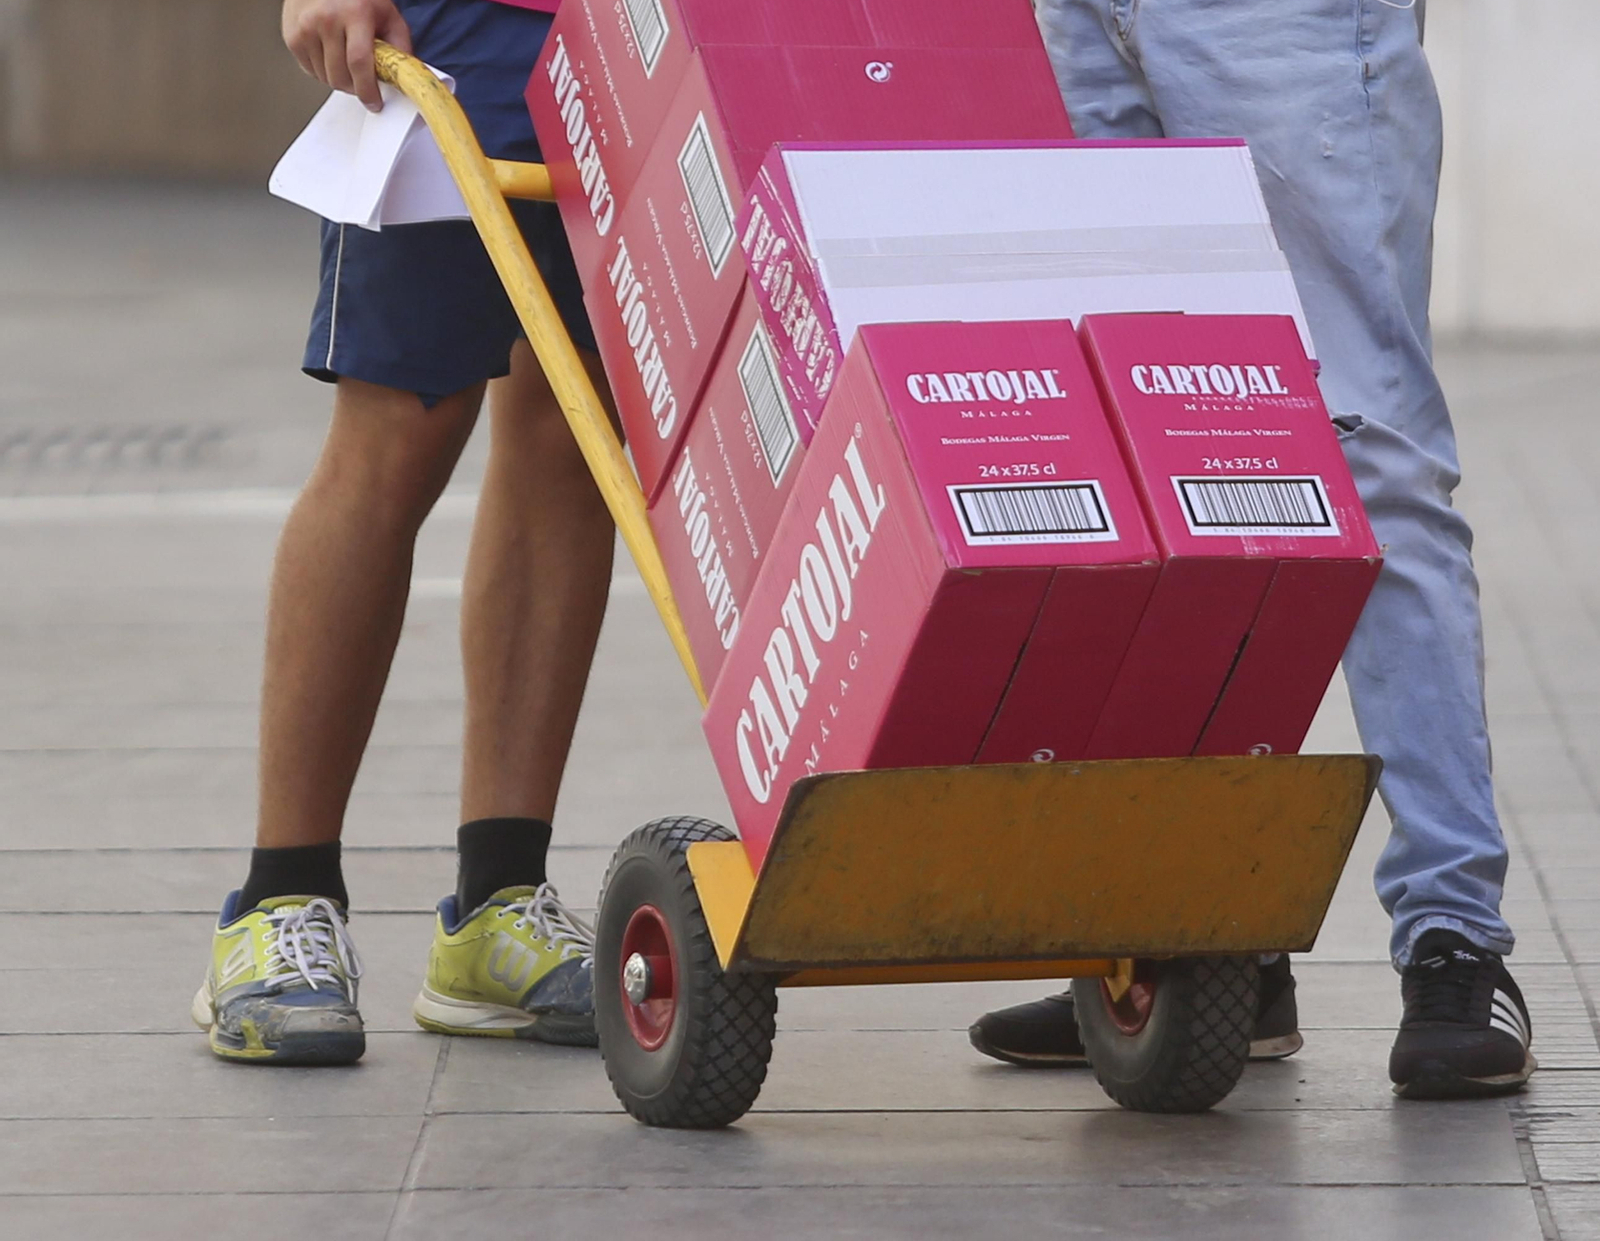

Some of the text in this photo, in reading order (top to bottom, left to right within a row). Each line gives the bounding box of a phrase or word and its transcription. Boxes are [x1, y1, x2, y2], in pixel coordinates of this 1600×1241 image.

[548, 33, 615, 236] CARTOJAL
[608, 235, 677, 439] CARTOJAL
[906, 369, 1067, 404] CARTOJAL
[1131, 364, 1289, 399] CARTOJAL
[941, 436, 986, 445] BODEGAS
[1031, 434, 1070, 442] VIRGEN
[673, 445, 739, 650] CARTOJAL
[736, 435, 886, 804] CARTOJAL
[804, 629, 869, 776] MÁLAGA
